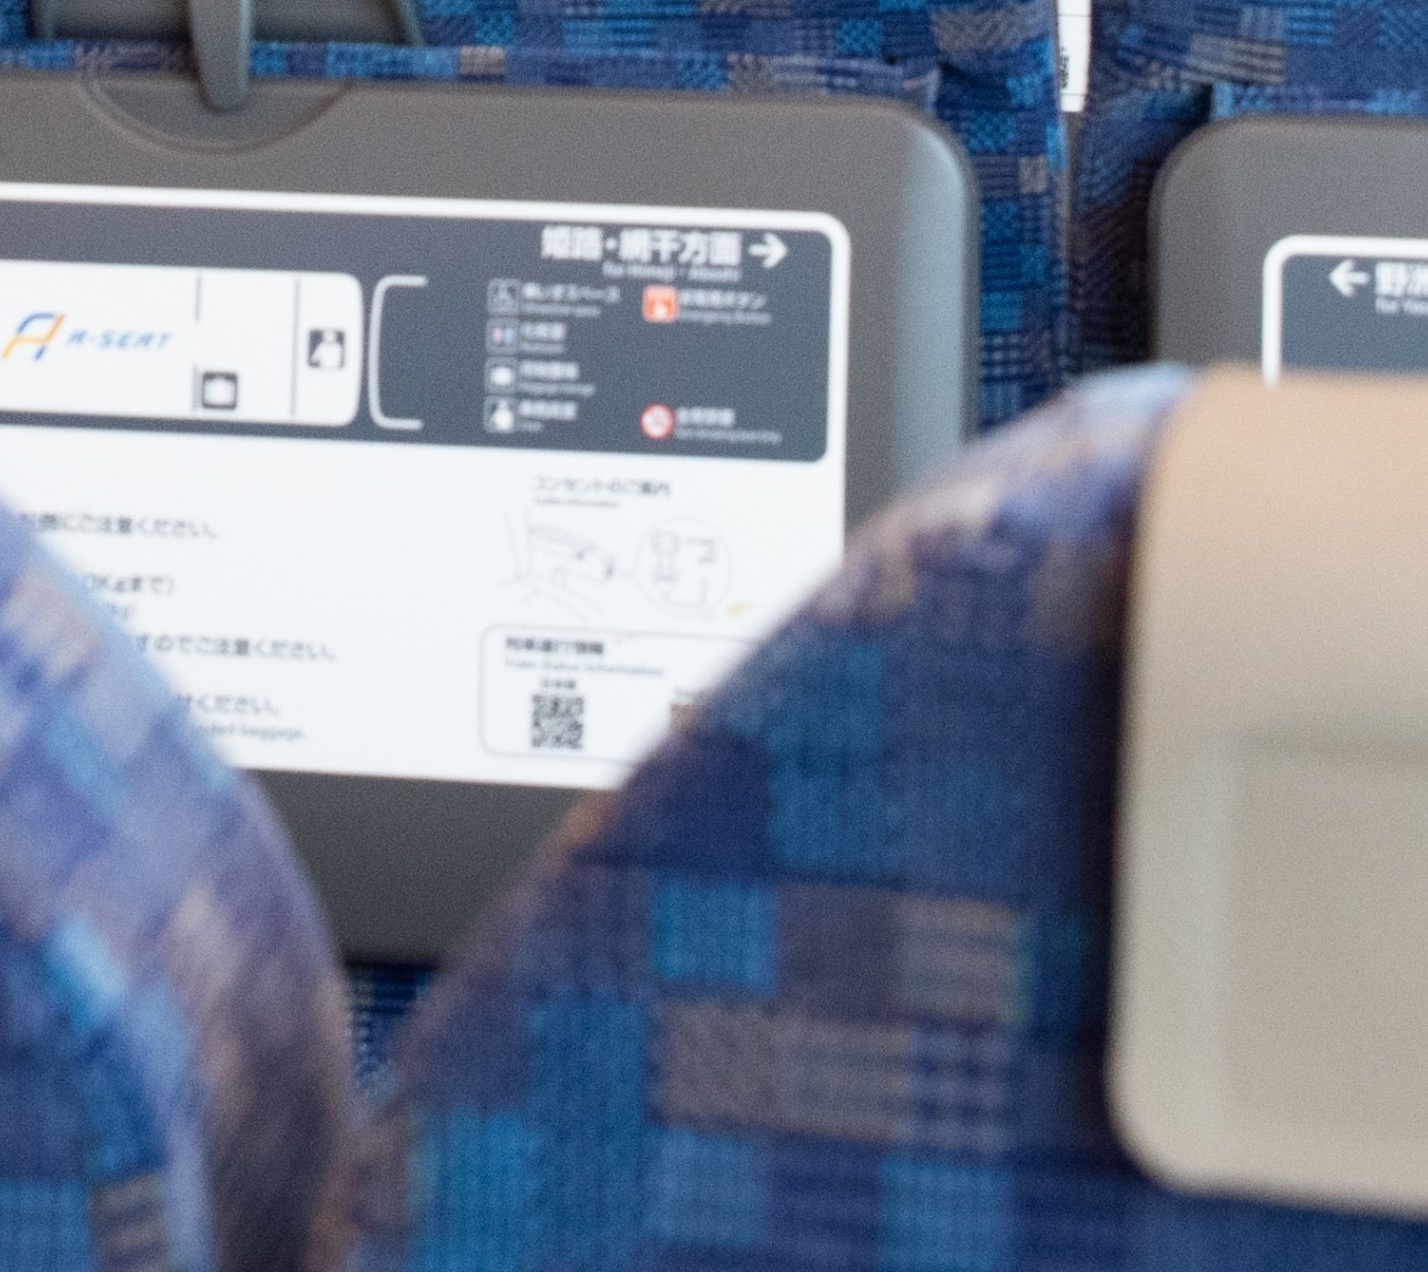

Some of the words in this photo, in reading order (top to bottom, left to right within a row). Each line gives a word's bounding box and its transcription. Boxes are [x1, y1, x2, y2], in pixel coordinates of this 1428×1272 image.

[541, 224, 742, 267] 姫路・網干方面
[67, 329, 172, 351] A-SEAT
